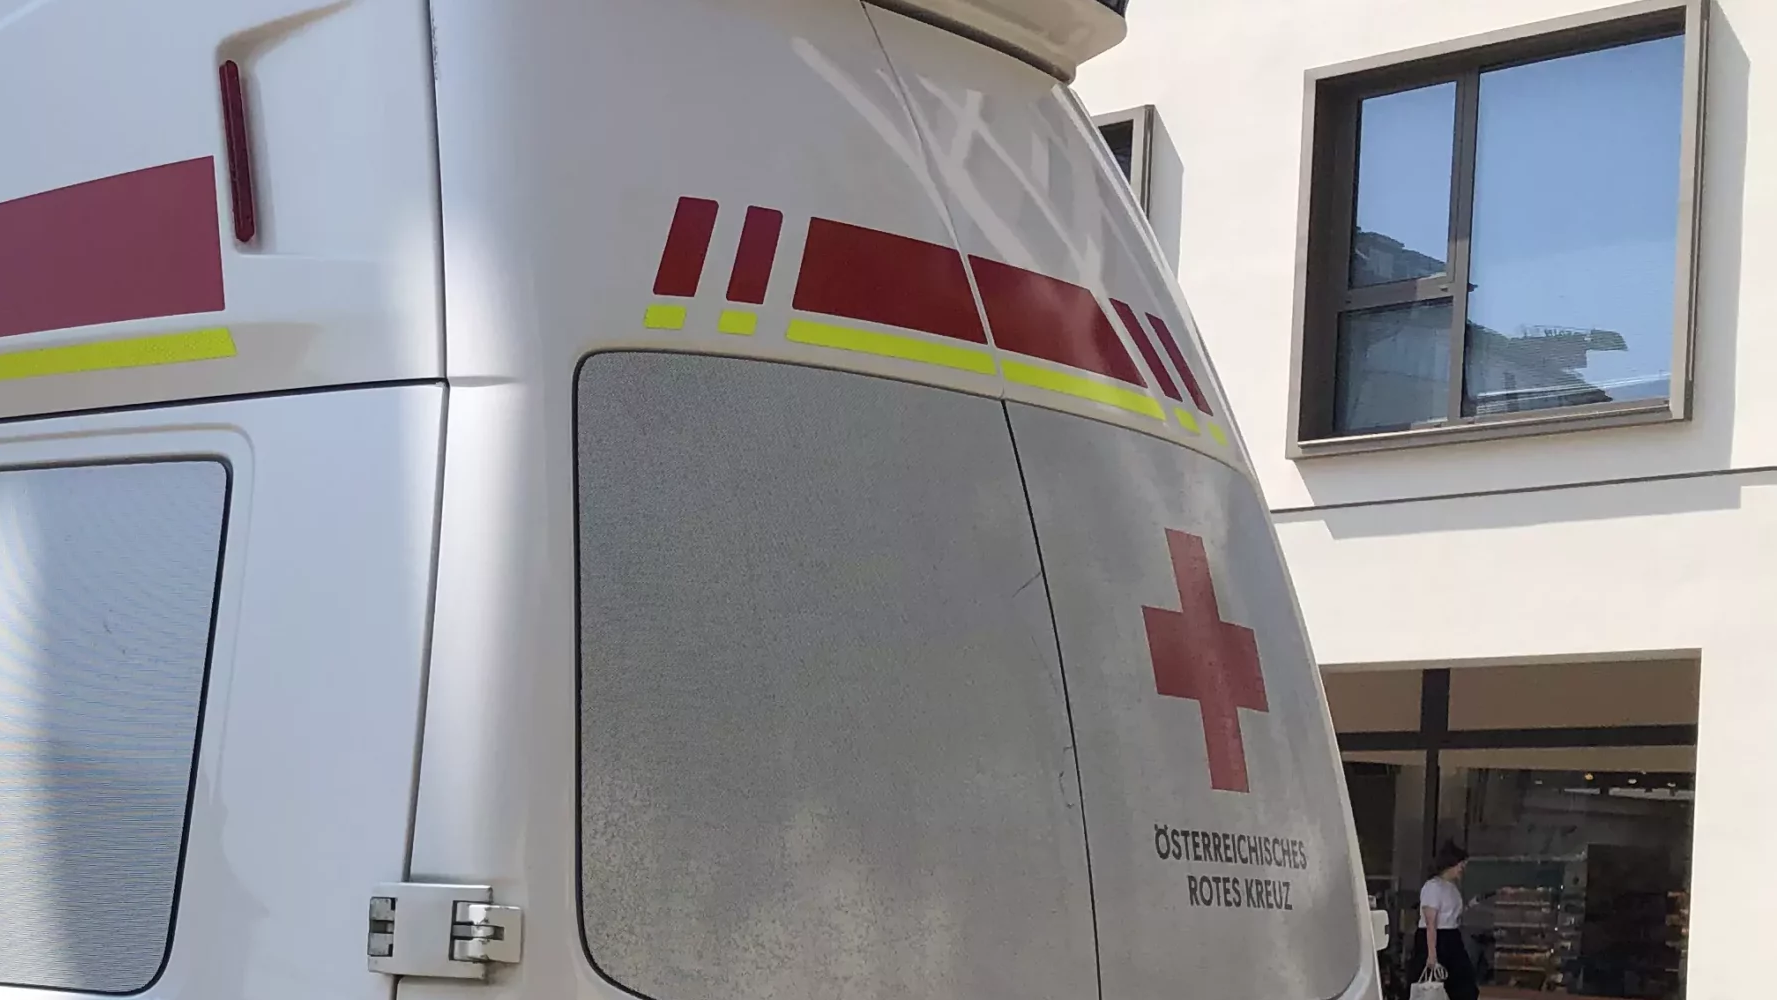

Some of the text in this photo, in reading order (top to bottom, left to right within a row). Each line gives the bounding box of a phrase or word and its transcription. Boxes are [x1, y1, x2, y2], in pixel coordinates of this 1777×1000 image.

[1154, 824, 1308, 870] ÖSTERREICHISCHES
[1187, 875, 1293, 911] ROTES KREUZ
